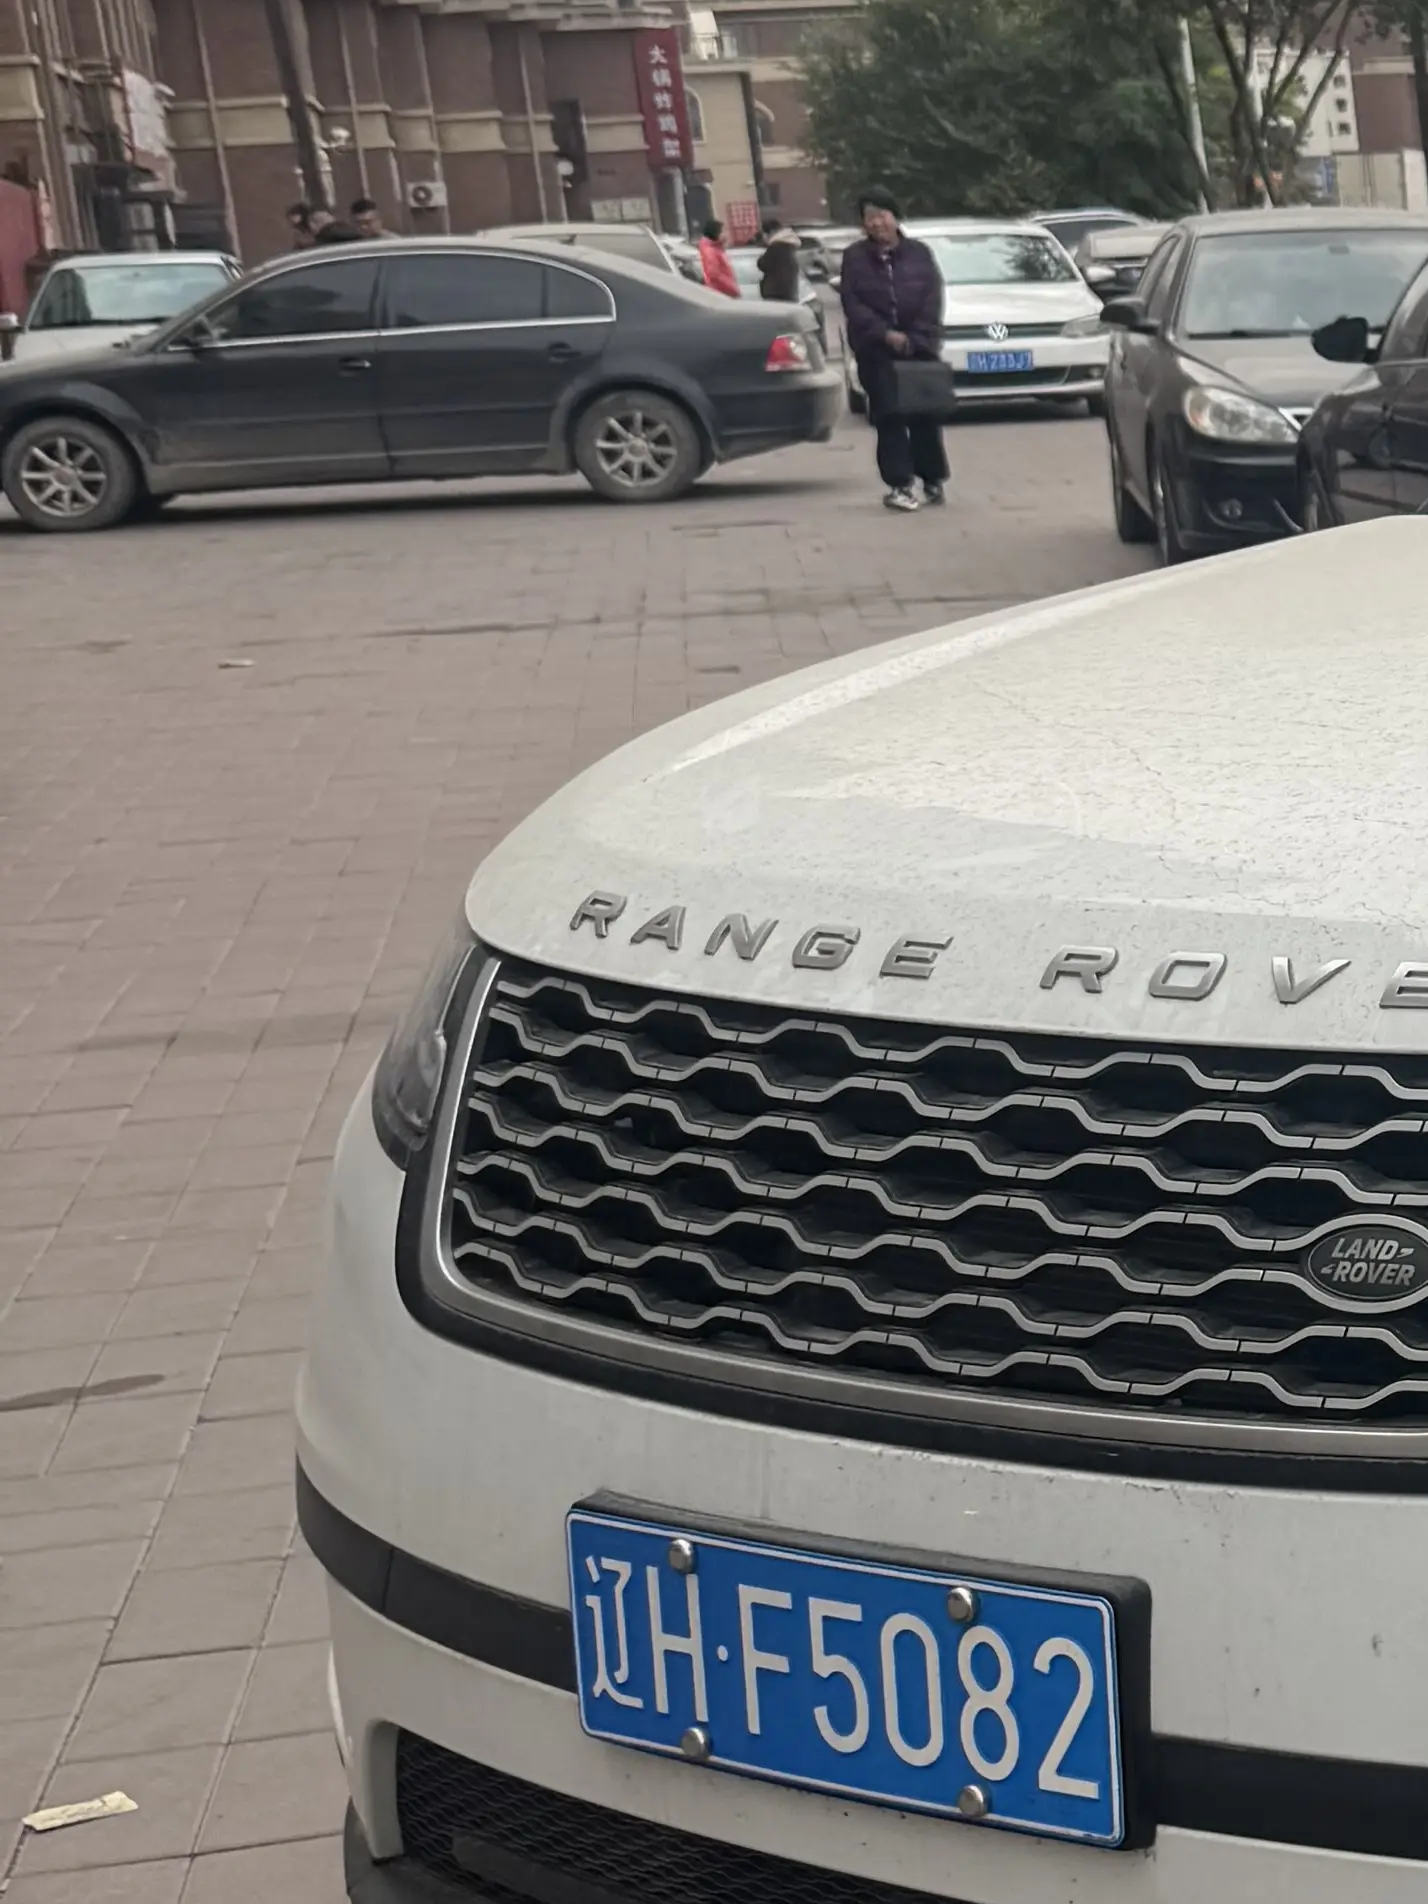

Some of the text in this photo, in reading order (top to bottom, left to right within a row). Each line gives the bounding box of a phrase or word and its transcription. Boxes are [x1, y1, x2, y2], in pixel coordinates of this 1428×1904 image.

[568, 889, 954, 980] RANGE
[1331, 1238, 1399, 1261] LAND
[1332, 1260, 1416, 1286] ROVER
